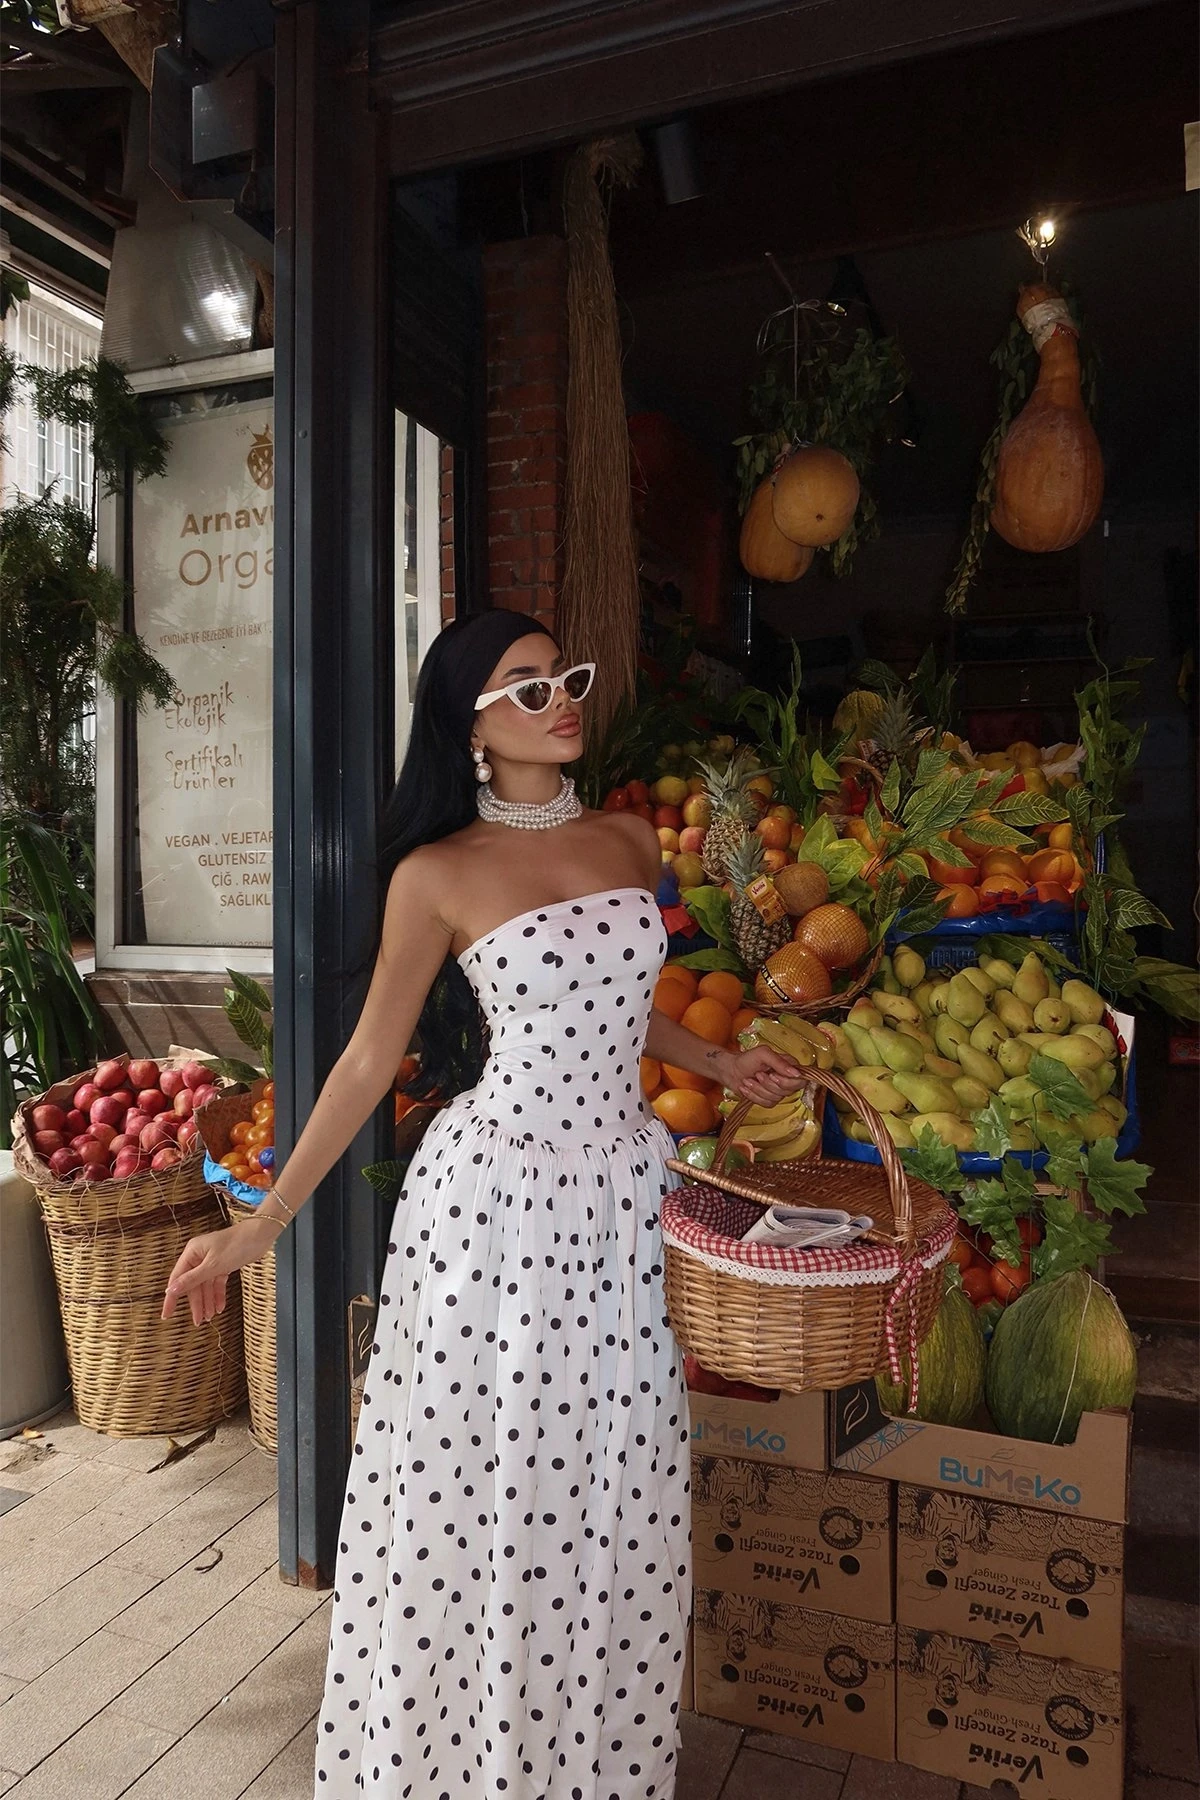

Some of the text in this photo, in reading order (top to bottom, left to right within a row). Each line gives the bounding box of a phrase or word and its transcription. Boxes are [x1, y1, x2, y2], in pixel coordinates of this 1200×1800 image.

[180, 504, 273, 538] Arnav
[191, 631, 199, 644] VE
[174, 680, 235, 714] Organik
[164, 703, 228, 736] Ekolojik
[164, 743, 244, 772] Sertifikalı
[165, 833, 210, 848] VEGAN
[211, 871, 232, 888] ÇİĞ
[242, 872, 272, 886] RAW
[940, 1456, 1081, 1505] BuMeKo
[739, 1535, 834, 1566] Taze Zencefil
[754, 1527, 817, 1548] Fresh Ginger
[972, 1567, 1041, 1590] Fresh Ginger
[954, 1575, 1060, 1611] Taze Zencefil
[743, 1669, 838, 1704] Taze Zencefil
[759, 1662, 821, 1685] Fresh Ginger
[954, 1715, 1016, 1743] Zencefil
[972, 1707, 1041, 1734] Fresh Ginger
[1020, 1733, 1060, 1755] Taze
